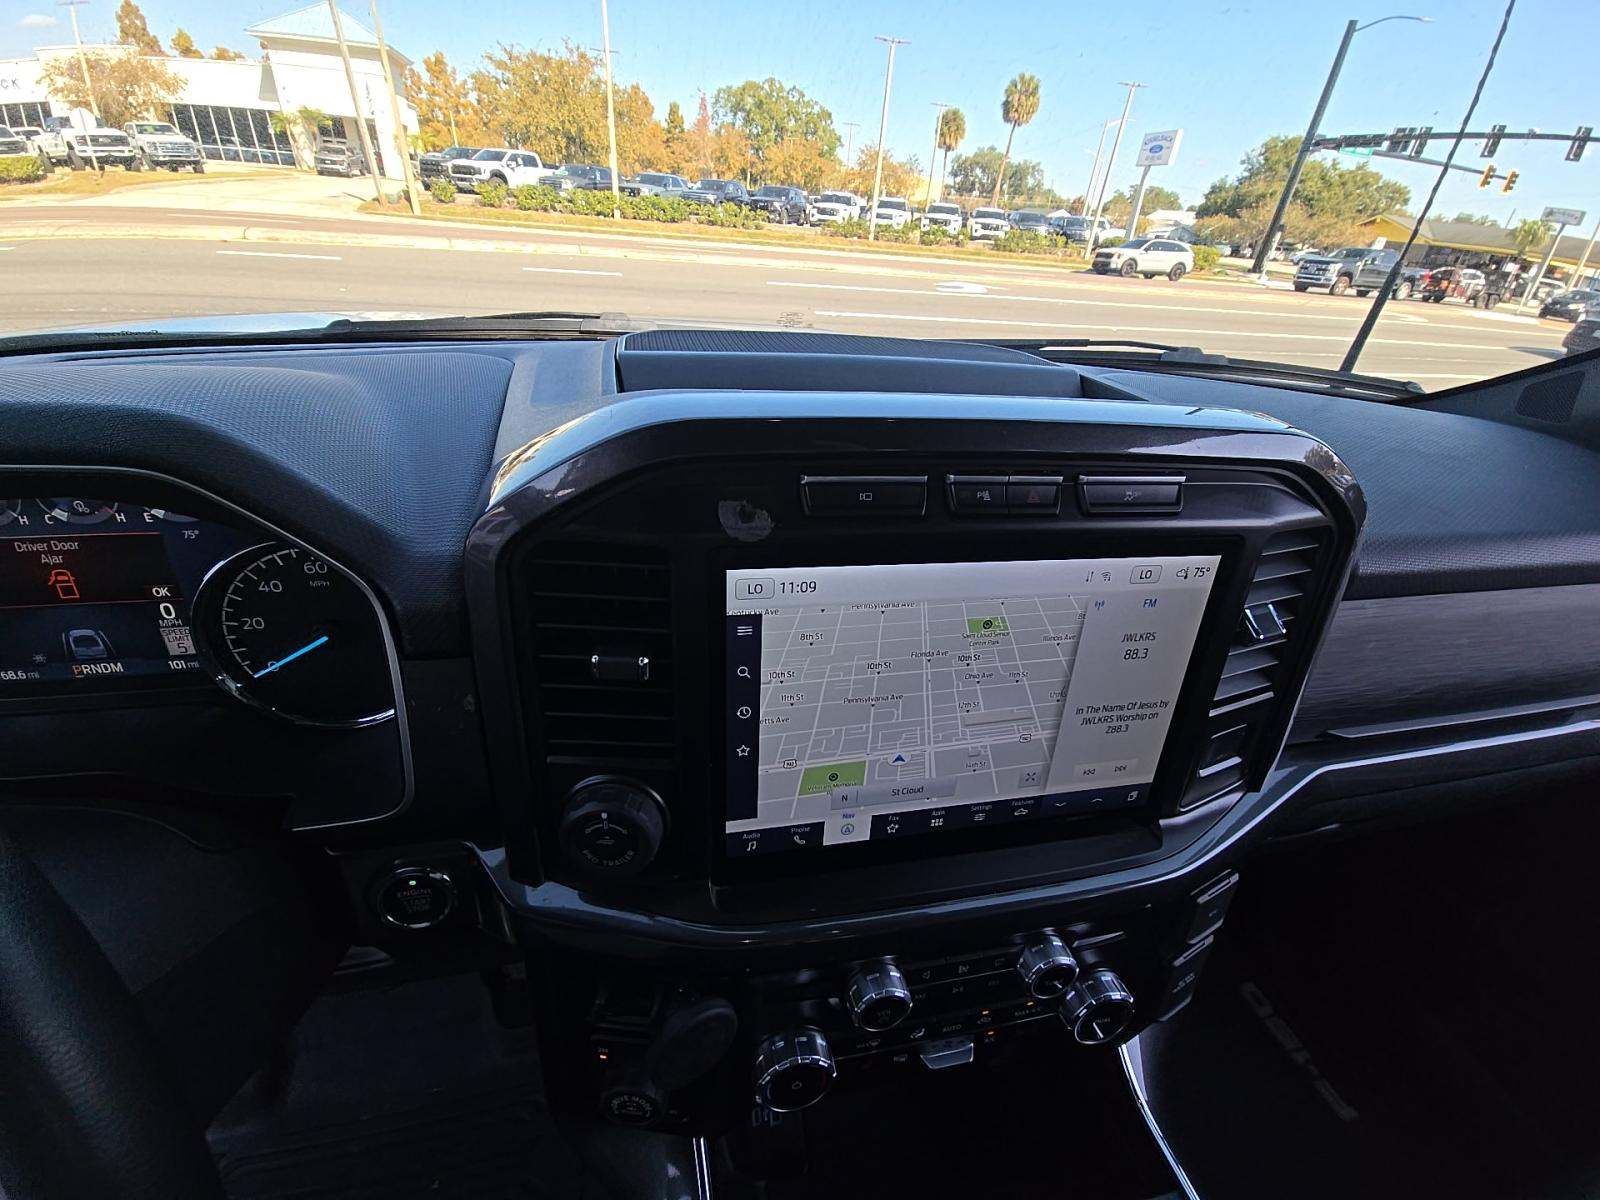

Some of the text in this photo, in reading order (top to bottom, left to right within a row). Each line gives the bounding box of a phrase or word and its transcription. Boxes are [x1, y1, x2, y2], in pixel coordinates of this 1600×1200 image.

[18, 515, 29, 525] H
[114, 512, 127, 523] H
[143, 512, 154, 523] E
[14, 540, 80, 553] Driver Door
[41, 553, 64, 565] Ajar
[303, 561, 328, 574] 60
[1139, 569, 1153, 579] LO
[152, 586, 171, 598] OK
[258, 580, 283, 593] 40
[747, 583, 763, 595] LO
[779, 580, 817, 595] 11:09
[1143, 598, 1157, 609] FM
[160, 602, 176, 619] 0
[764, 608, 780, 616] Ave
[159, 618, 183, 627] MPH
[240, 617, 265, 630] 20
[799, 632, 824, 641] 8th St
[1063, 633, 1077, 641] Ave
[1121, 631, 1157, 644] JWLKRS
[177, 642, 189, 654] 5
[910, 649, 949, 659] Florida Ave
[957, 653, 981, 662] 10th St
[1123, 648, 1149, 661] 88.3
[168, 660, 200, 670] 101 mi
[867, 661, 892, 670] 10th St
[27, 671, 40, 680] mi
[768, 670, 796, 679] 10th St
[781, 693, 804, 702] 11th St
[843, 693, 904, 704] Pennsylvania Ave
[1075, 699, 1169, 716] In The Name Of Jesus by
[775, 716, 790, 724] Ave
[1080, 712, 1159, 726] JWLKRS Worship on
[891, 785, 924, 797] St Cloud
[841, 794, 848, 802] N
[790, 825, 811, 834] Phone
[742, 832, 761, 840] Audio
